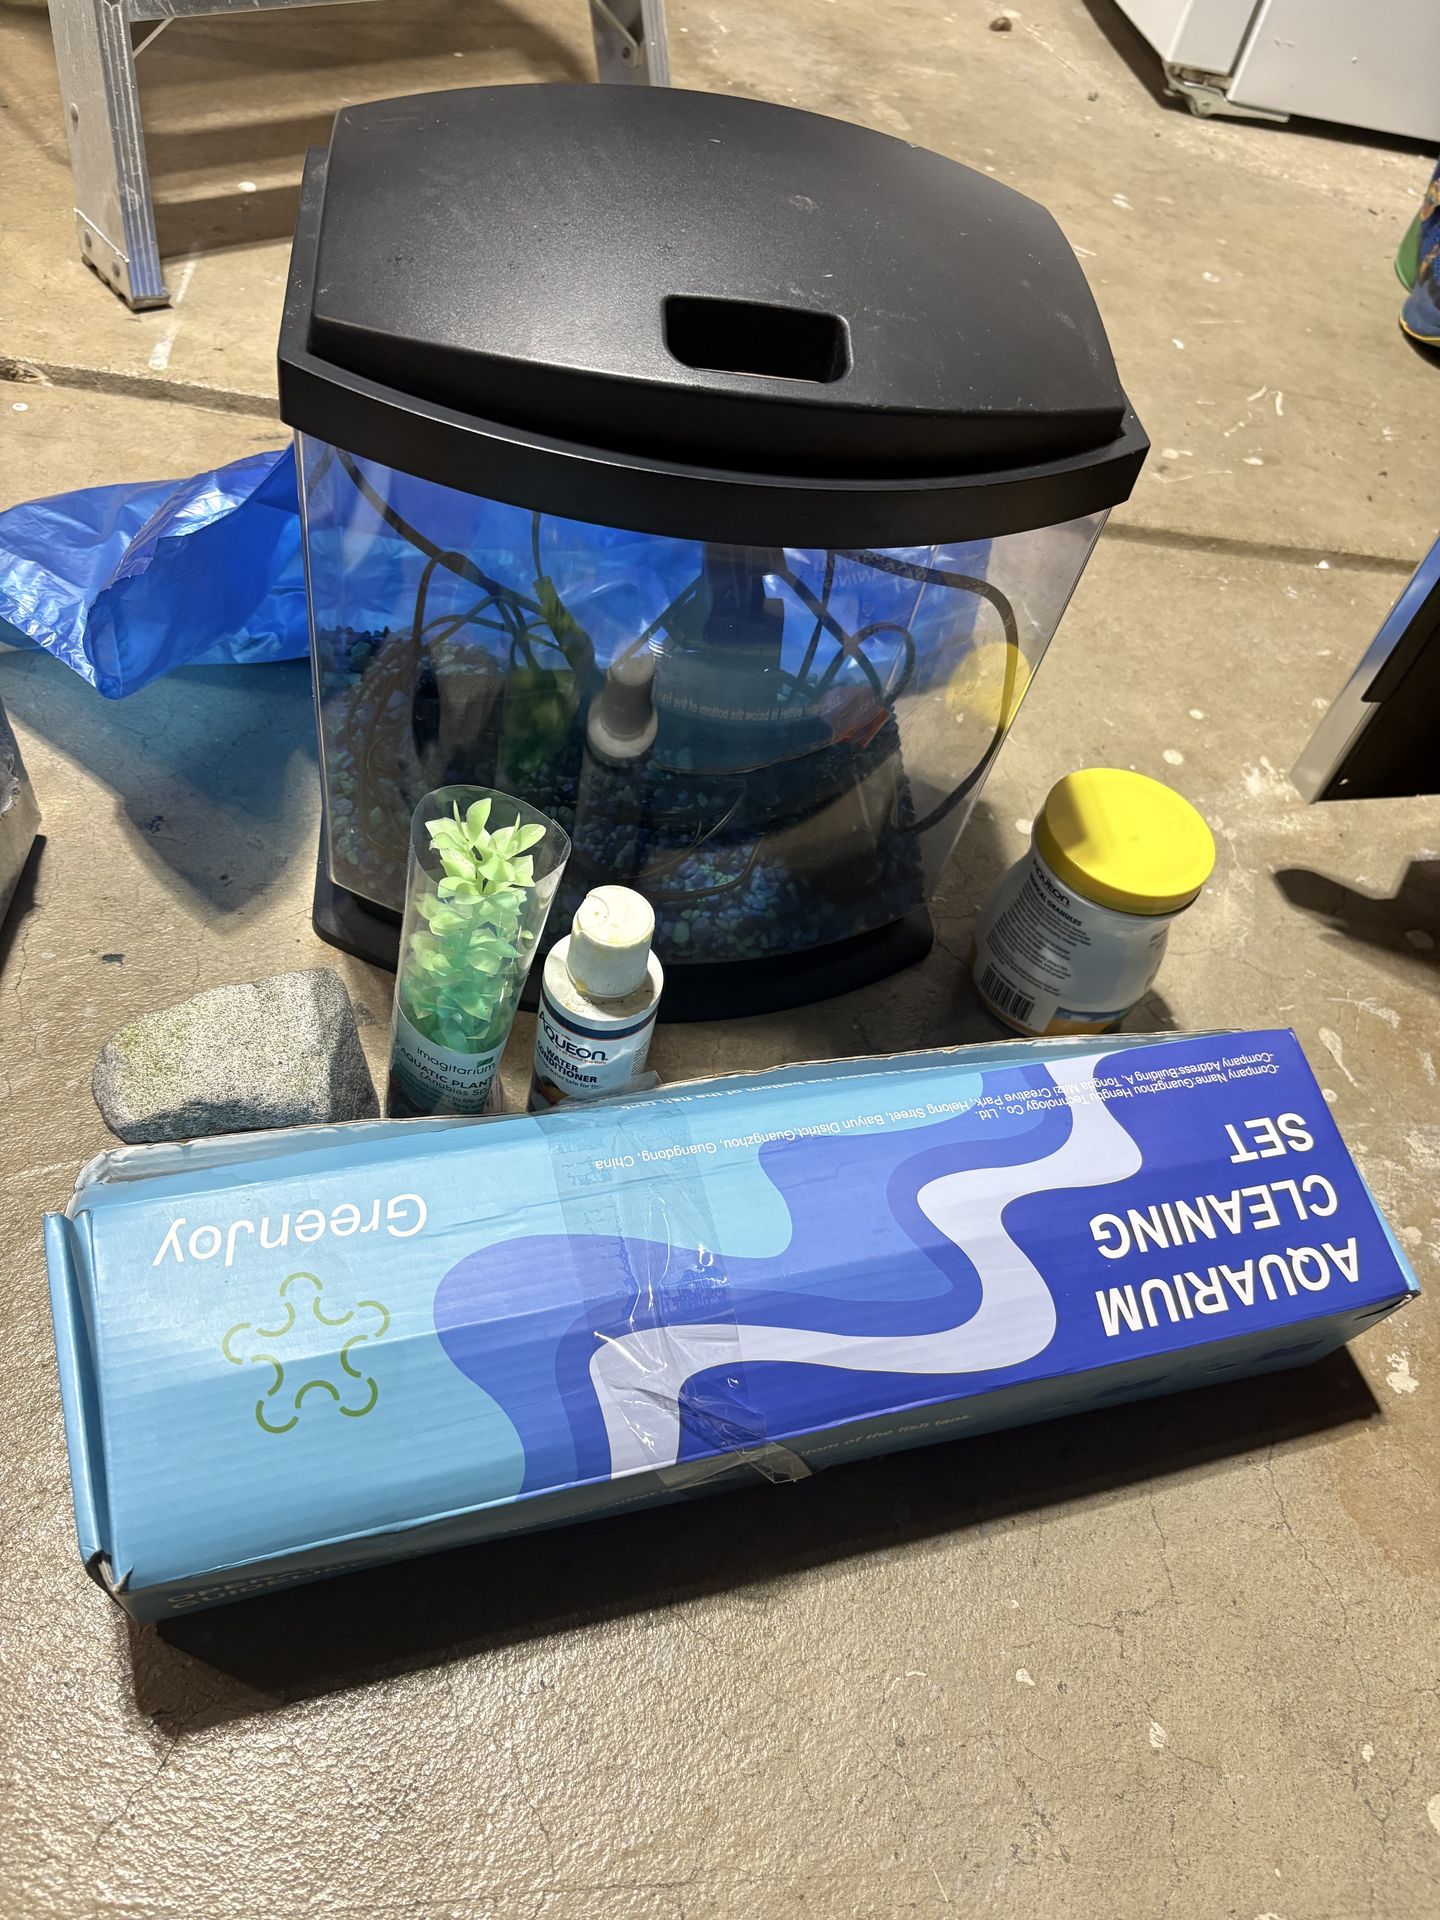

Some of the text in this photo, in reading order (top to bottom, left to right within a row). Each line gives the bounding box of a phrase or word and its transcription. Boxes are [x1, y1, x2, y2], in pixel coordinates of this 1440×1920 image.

[1047, 900, 1082, 927] GRANULES
[539, 1010, 605, 1061] AQUEON
[401, 1047, 448, 1083] AQUATIC
[417, 1046, 495, 1075] imagitarium
[537, 1040, 598, 1083] CONDITIONER
[547, 1046, 579, 1073] WATER
[746, 1082, 804, 1092] bottom
[1082, 1076, 1122, 1091] Tongda
[1121, 1074, 1134, 1085] A,
[969, 1095, 1002, 1108] Park,
[1004, 1087, 1050, 1101] Creative
[1026, 1093, 1089, 1112] Technology
[1090, 1086, 1133, 1102] Hengbu
[886, 1108, 926, 1123] Street,
[926, 1101, 970, 1115] Helong
[975, 1108, 999, 1121] Ltd.
[998, 1104, 1025, 1116] Co.,
[843, 1115, 885, 1130] Baiyun
[1224, 1113, 1314, 1164] SET
[637, 1142, 717, 1162] Guangdong,
[595, 1154, 634, 1170] China
[1089, 1174, 1338, 1259] CLEANING
[152, 1193, 428, 1267] GreenJoy
[1095, 1237, 1359, 1337] AQUARIUM
